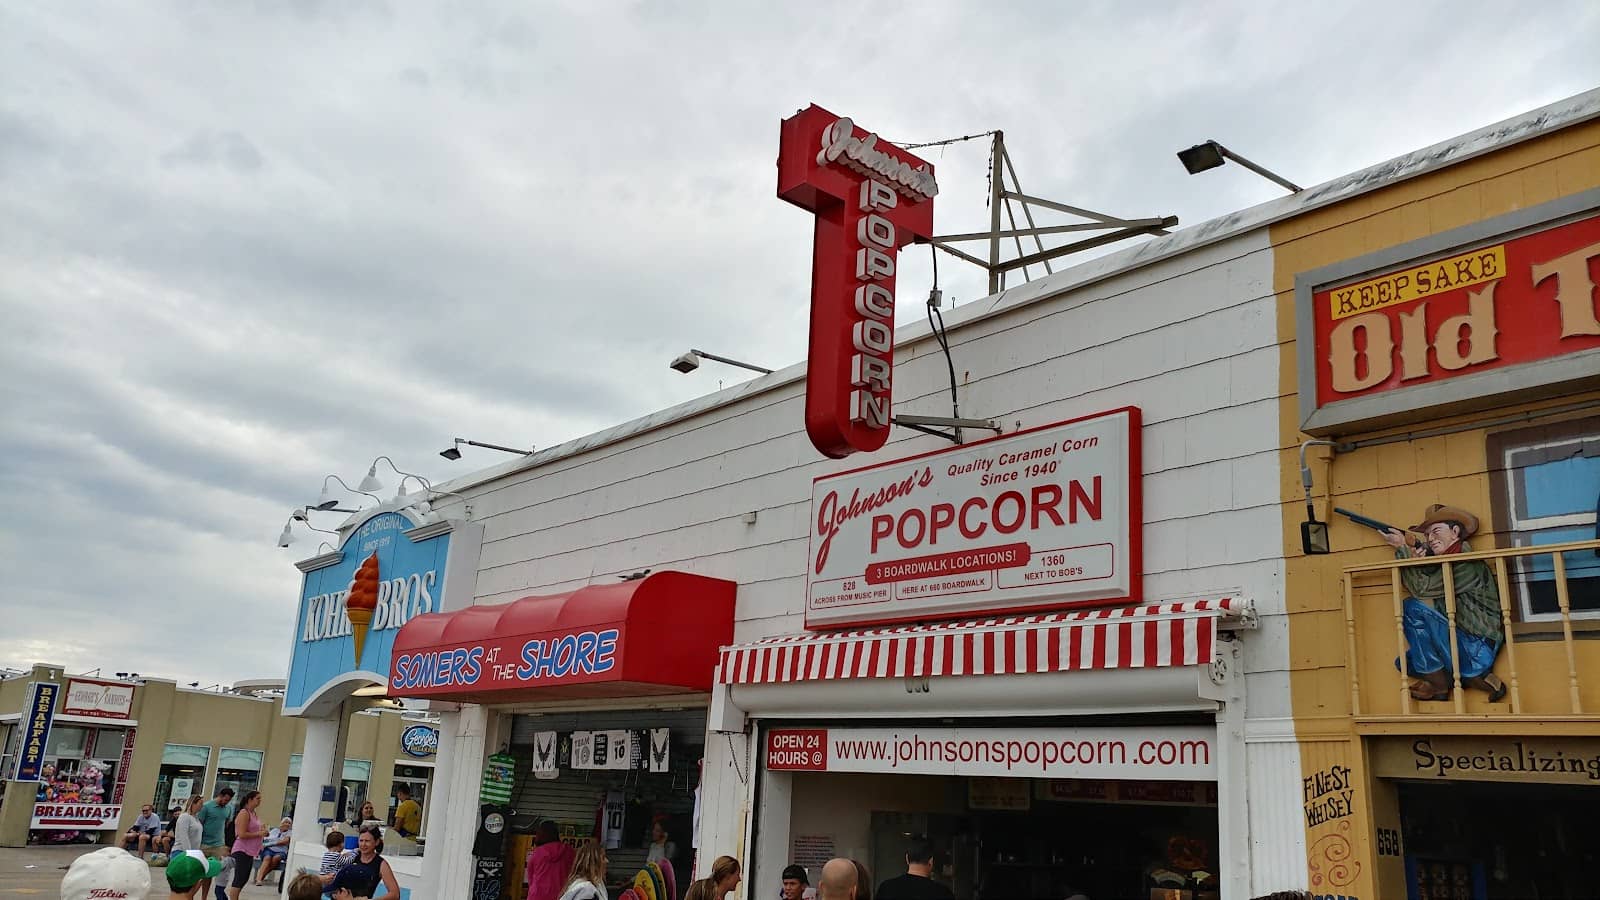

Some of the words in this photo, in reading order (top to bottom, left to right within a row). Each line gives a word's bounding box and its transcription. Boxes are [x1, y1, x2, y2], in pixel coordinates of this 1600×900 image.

[816, 117, 939, 201] Johnson's
[850, 179, 898, 428] POPCORN
[1328, 280, 1501, 393] Old
[947, 457, 994, 477] Quality
[999, 442, 1057, 466] Caramel
[1062, 436, 1099, 453] Corn
[980, 471, 1018, 487] Since
[1024, 460, 1058, 479] 1940
[370, 514, 404, 534] ORIGINAL
[816, 466, 934, 575] Johnson's
[870, 475, 1103, 555] POPCORN
[876, 568, 882, 579] 3
[884, 559, 947, 578] BOARDWALK
[950, 549, 1017, 570] LOCATIONS!
[1024, 571, 1044, 581] NEXT
[1046, 570, 1056, 578] TO
[1058, 566, 1083, 577] BOB'S
[1041, 554, 1065, 567] 1360
[371, 569, 436, 631] BROS
[837, 593, 853, 602] FROM
[854, 591, 872, 600] MUSIC
[873, 589, 887, 598] PIER
[902, 586, 919, 594] HERE
[920, 585, 928, 593] AT
[942, 577, 985, 590] BOARDWALK
[392, 646, 484, 690] SOMERS
[485, 647, 501, 664] AT
[516, 629, 619, 681] SHORE
[492, 663, 516, 681] THE
[26, 687, 53, 763] BREAKFAST
[614, 745, 625, 760] 10
[773, 735, 805, 749] OPEN
[807, 735, 820, 748] 24
[769, 751, 808, 766] HOURS
[812, 751, 823, 766] @
[1412, 739, 1600, 780] Specializing
[34, 805, 121, 818] BREAKFAST
[607, 811, 622, 830] 10
[1304, 790, 1354, 828] WHISEY
[1377, 828, 1400, 857] 658
